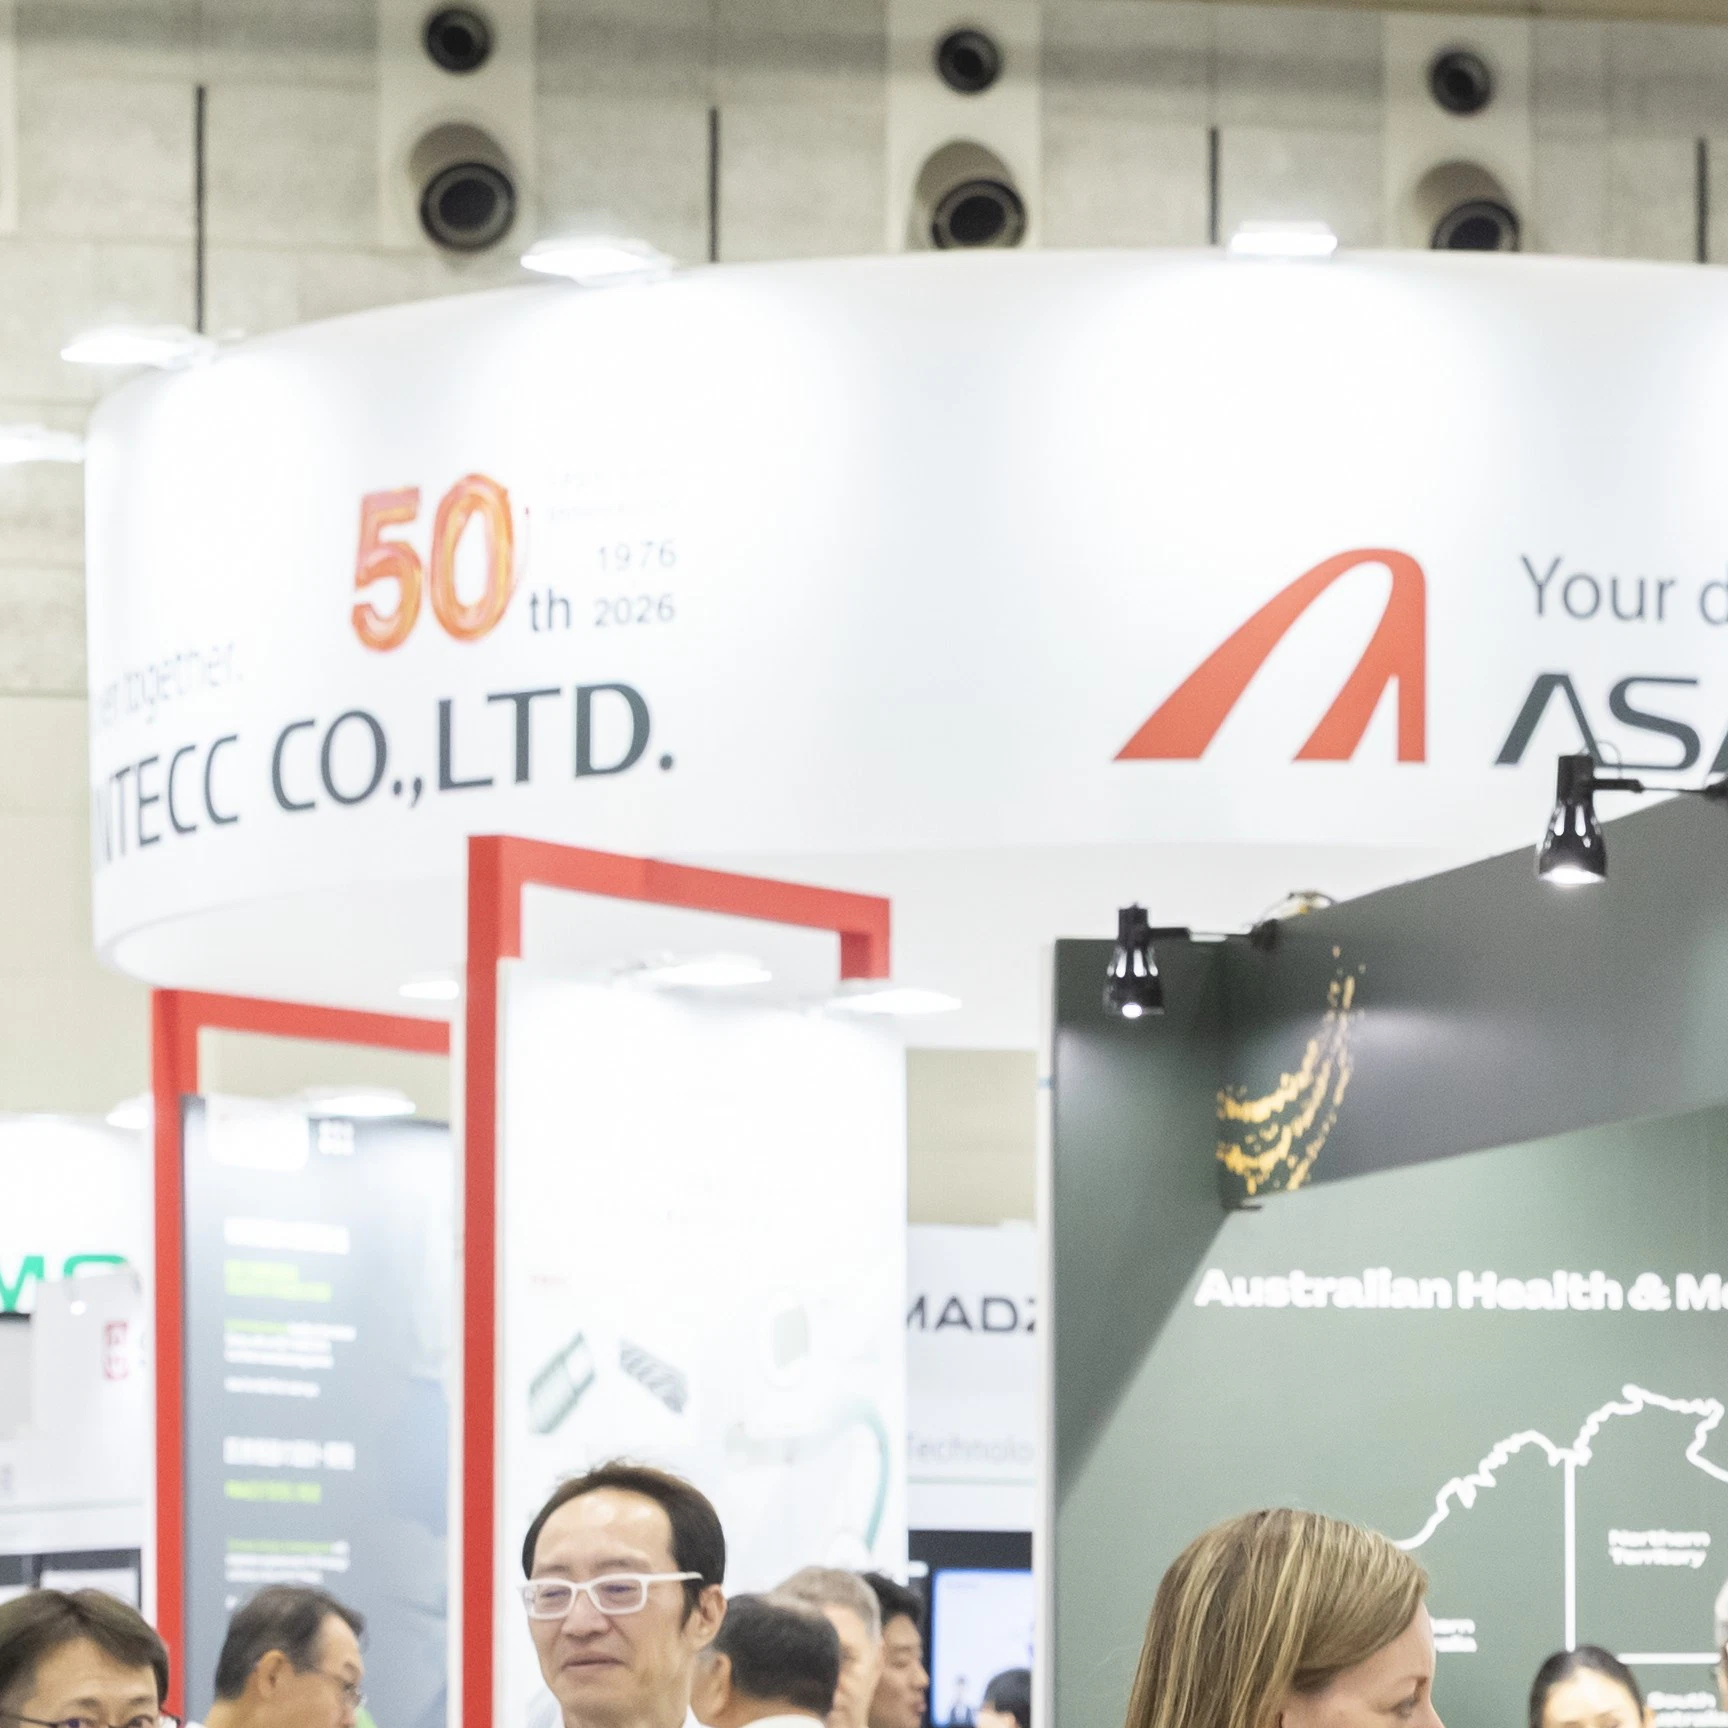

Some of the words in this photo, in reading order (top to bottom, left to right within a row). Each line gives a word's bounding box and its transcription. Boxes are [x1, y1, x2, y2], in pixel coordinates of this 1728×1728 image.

[593, 592, 677, 628] 2026
[1522, 554, 1674, 624] Your
[1194, 1267, 1453, 1310] Australian
[1456, 1269, 1624, 1311] Health
[1627, 1272, 1672, 1312] &
